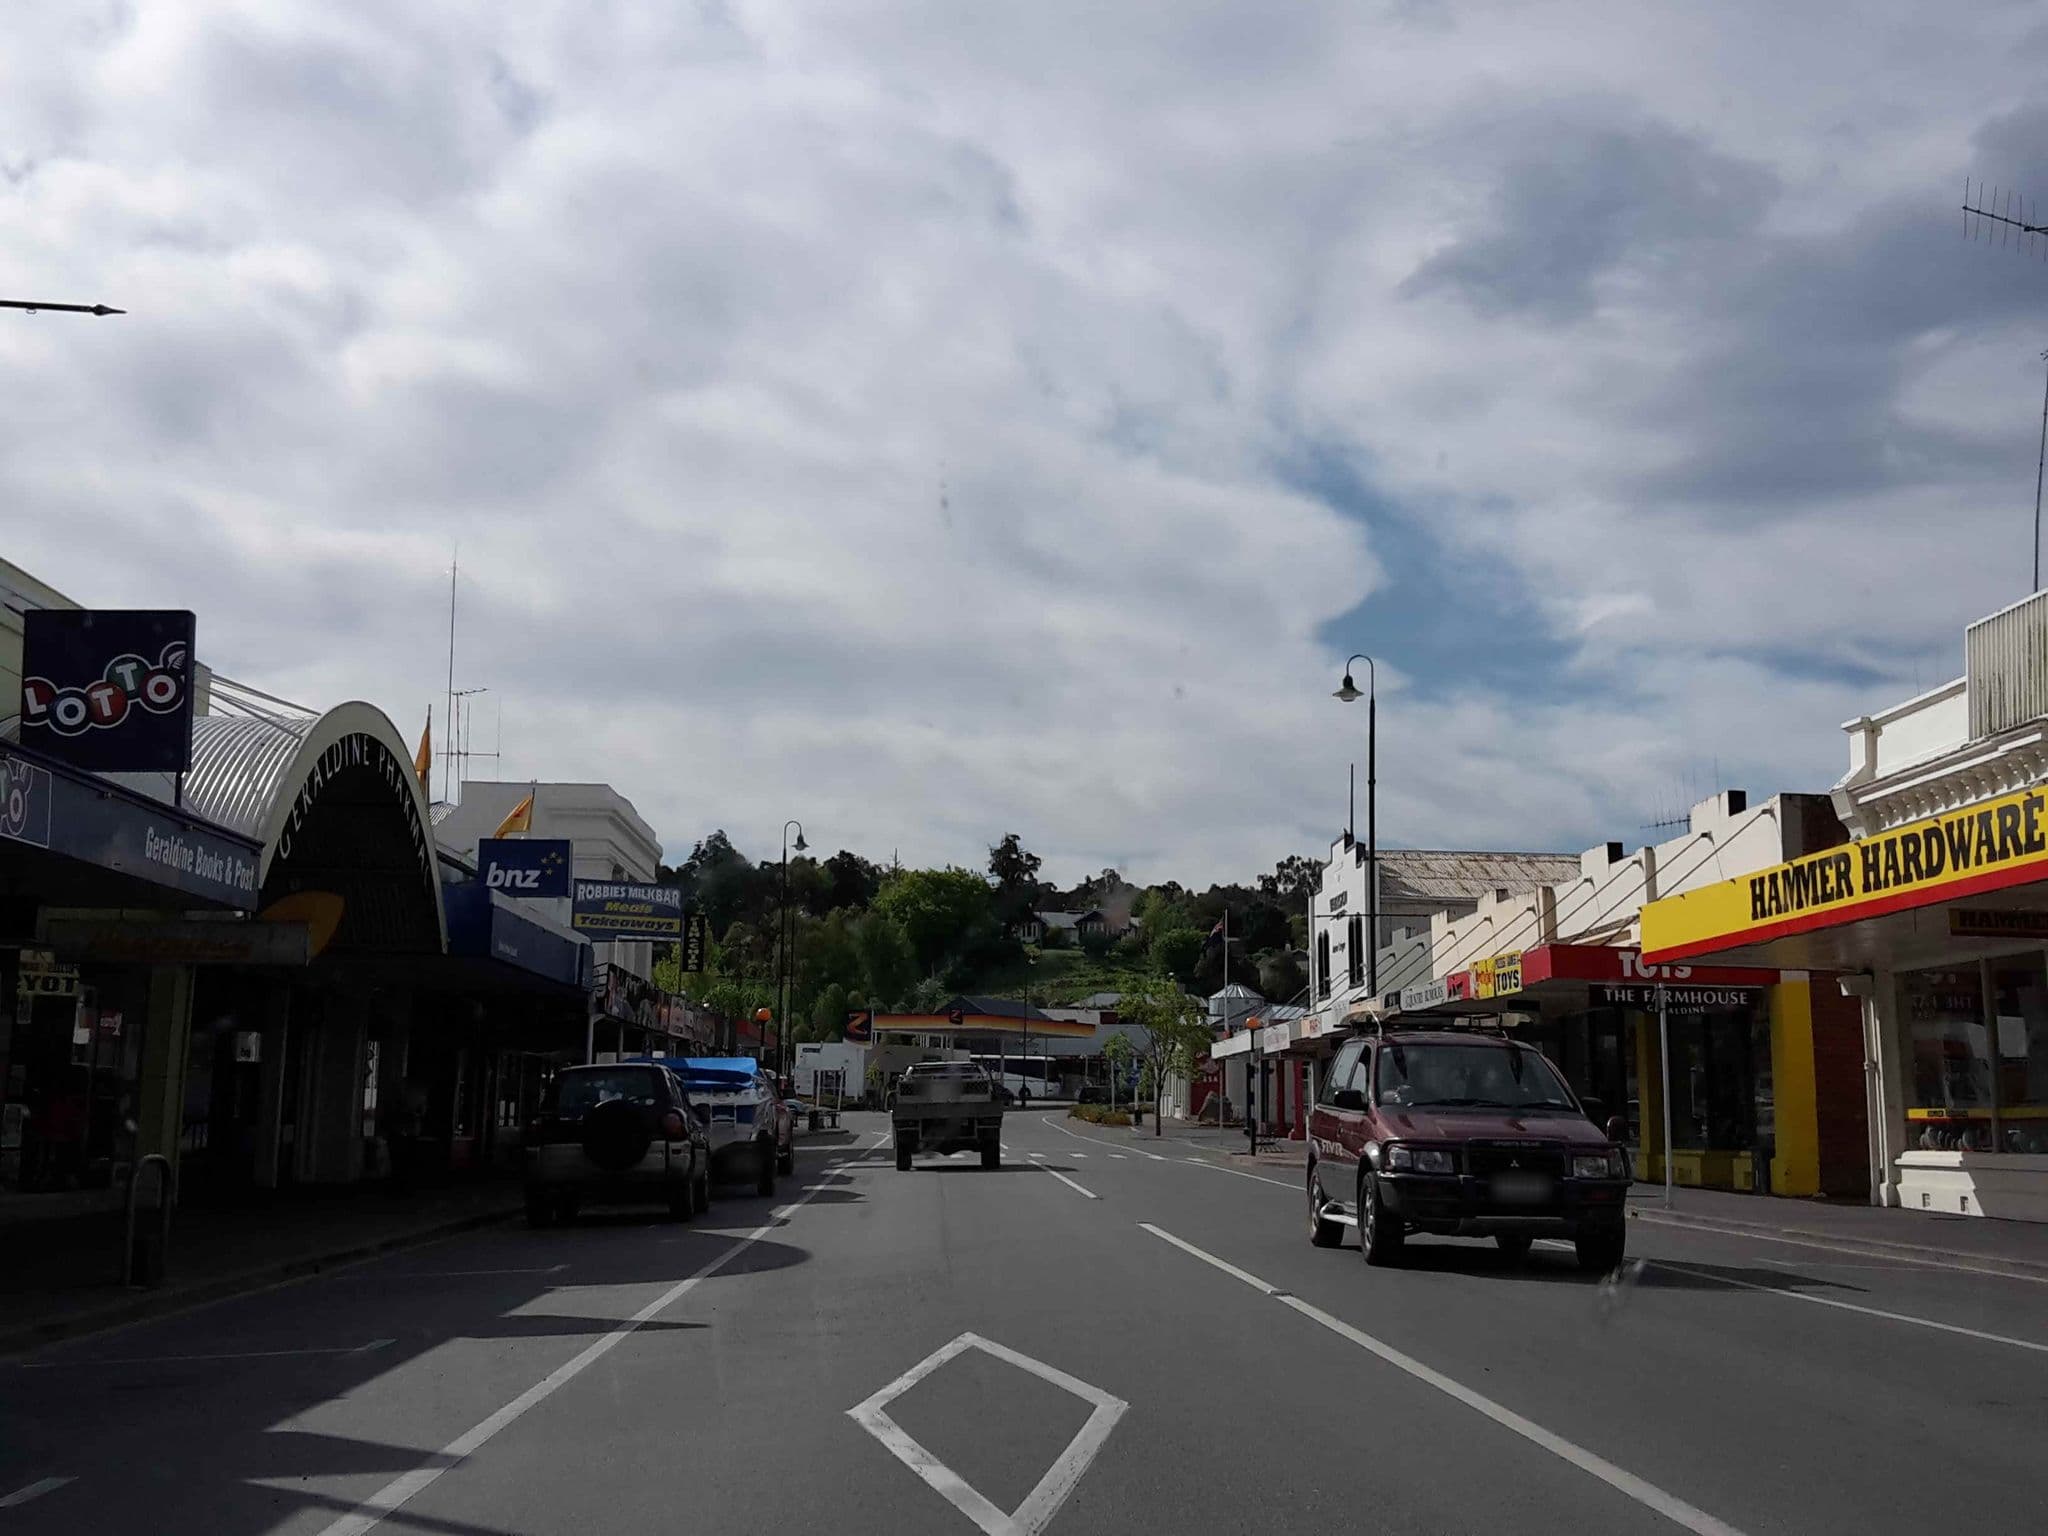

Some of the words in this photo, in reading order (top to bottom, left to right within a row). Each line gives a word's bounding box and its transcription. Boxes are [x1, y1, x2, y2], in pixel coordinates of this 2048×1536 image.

[25, 662, 176, 726] LOTTO
[278, 733, 370, 859] GERALDINE
[145, 826, 194, 873] Geraldine
[195, 845, 224, 882] Books
[224, 855, 233, 885] &
[233, 859, 255, 892] Post
[1750, 852, 1854, 921] HAMMER
[1861, 795, 2046, 893] HARDWARE
[486, 861, 542, 888] bnz
[577, 883, 626, 901] ROBBIES
[628, 887, 681, 909] MILKBAR
[580, 915, 675, 931] Takeaways
[1496, 969, 1519, 993] TOYS
[1604, 989, 1635, 1002] THE
[1647, 1004, 1705, 1015] GALDINE
